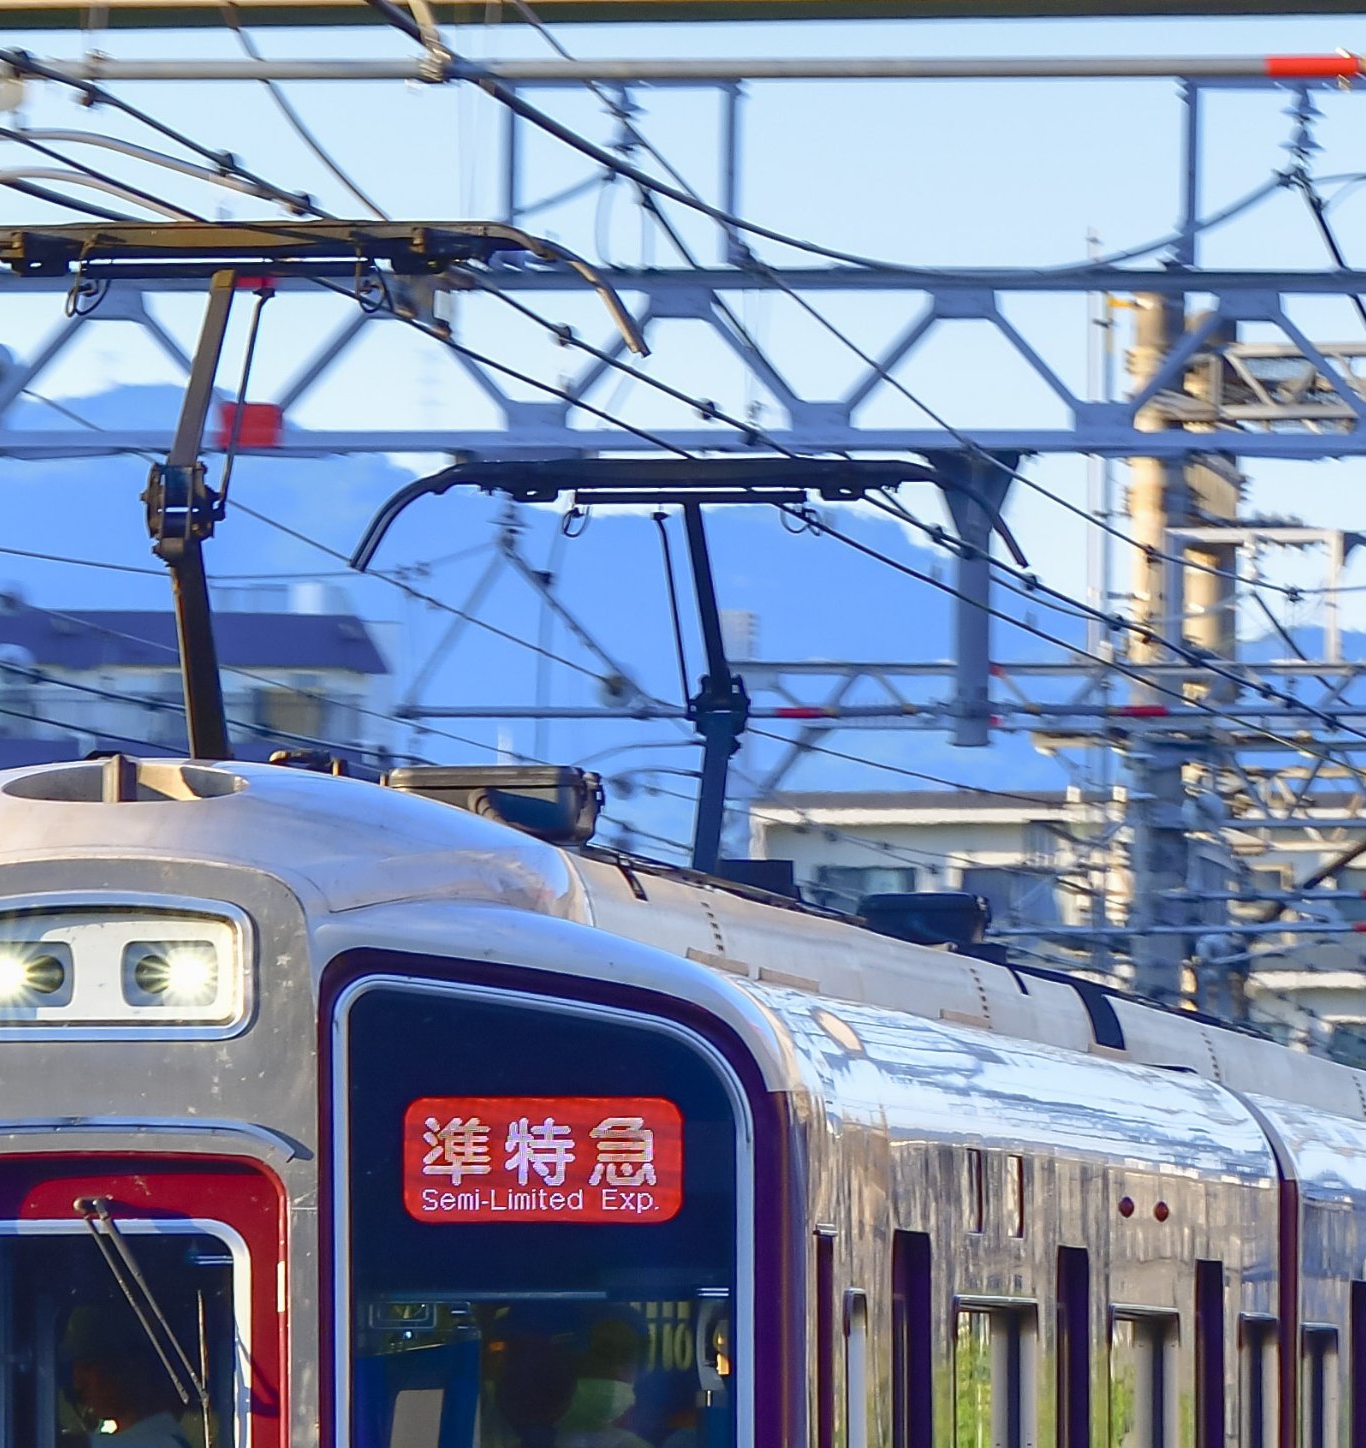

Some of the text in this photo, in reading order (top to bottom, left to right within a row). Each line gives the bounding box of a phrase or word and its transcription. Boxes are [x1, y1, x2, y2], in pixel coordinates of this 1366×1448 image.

[422, 1117, 657, 1187] 準特急
[422, 1189, 660, 1214] Semi-Limited Exp.
